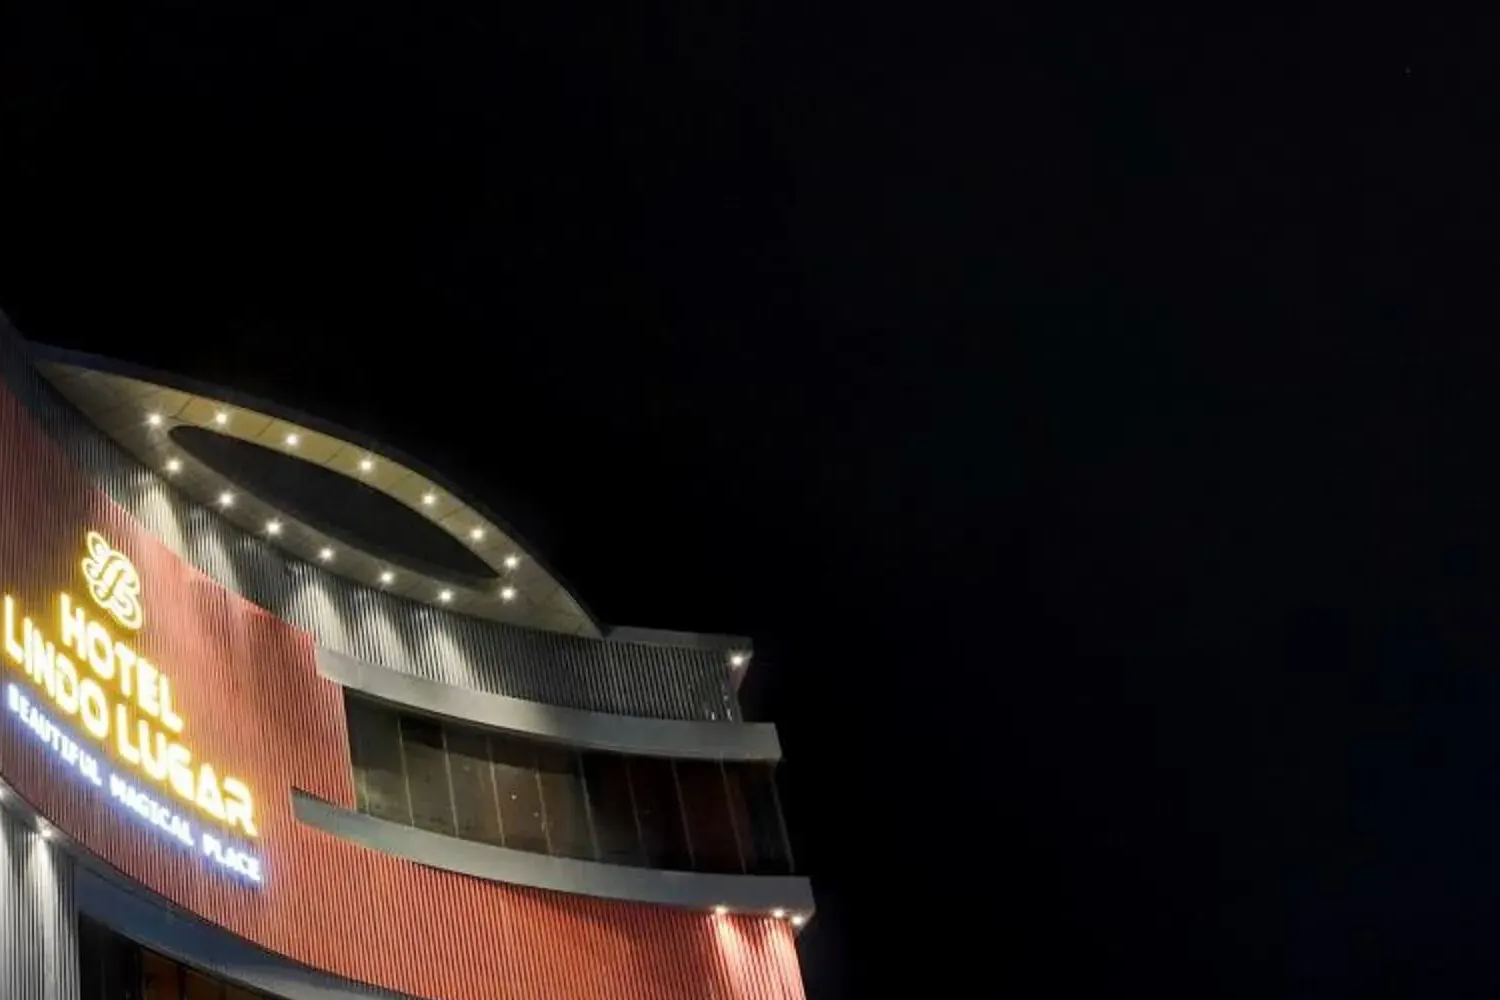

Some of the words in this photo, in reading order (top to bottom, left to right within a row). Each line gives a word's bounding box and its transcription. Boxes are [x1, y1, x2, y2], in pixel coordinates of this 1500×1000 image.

[4, 594, 109, 739] LINDO
[115, 703, 257, 837] LUGAR
[59, 592, 184, 733] HOTEL
